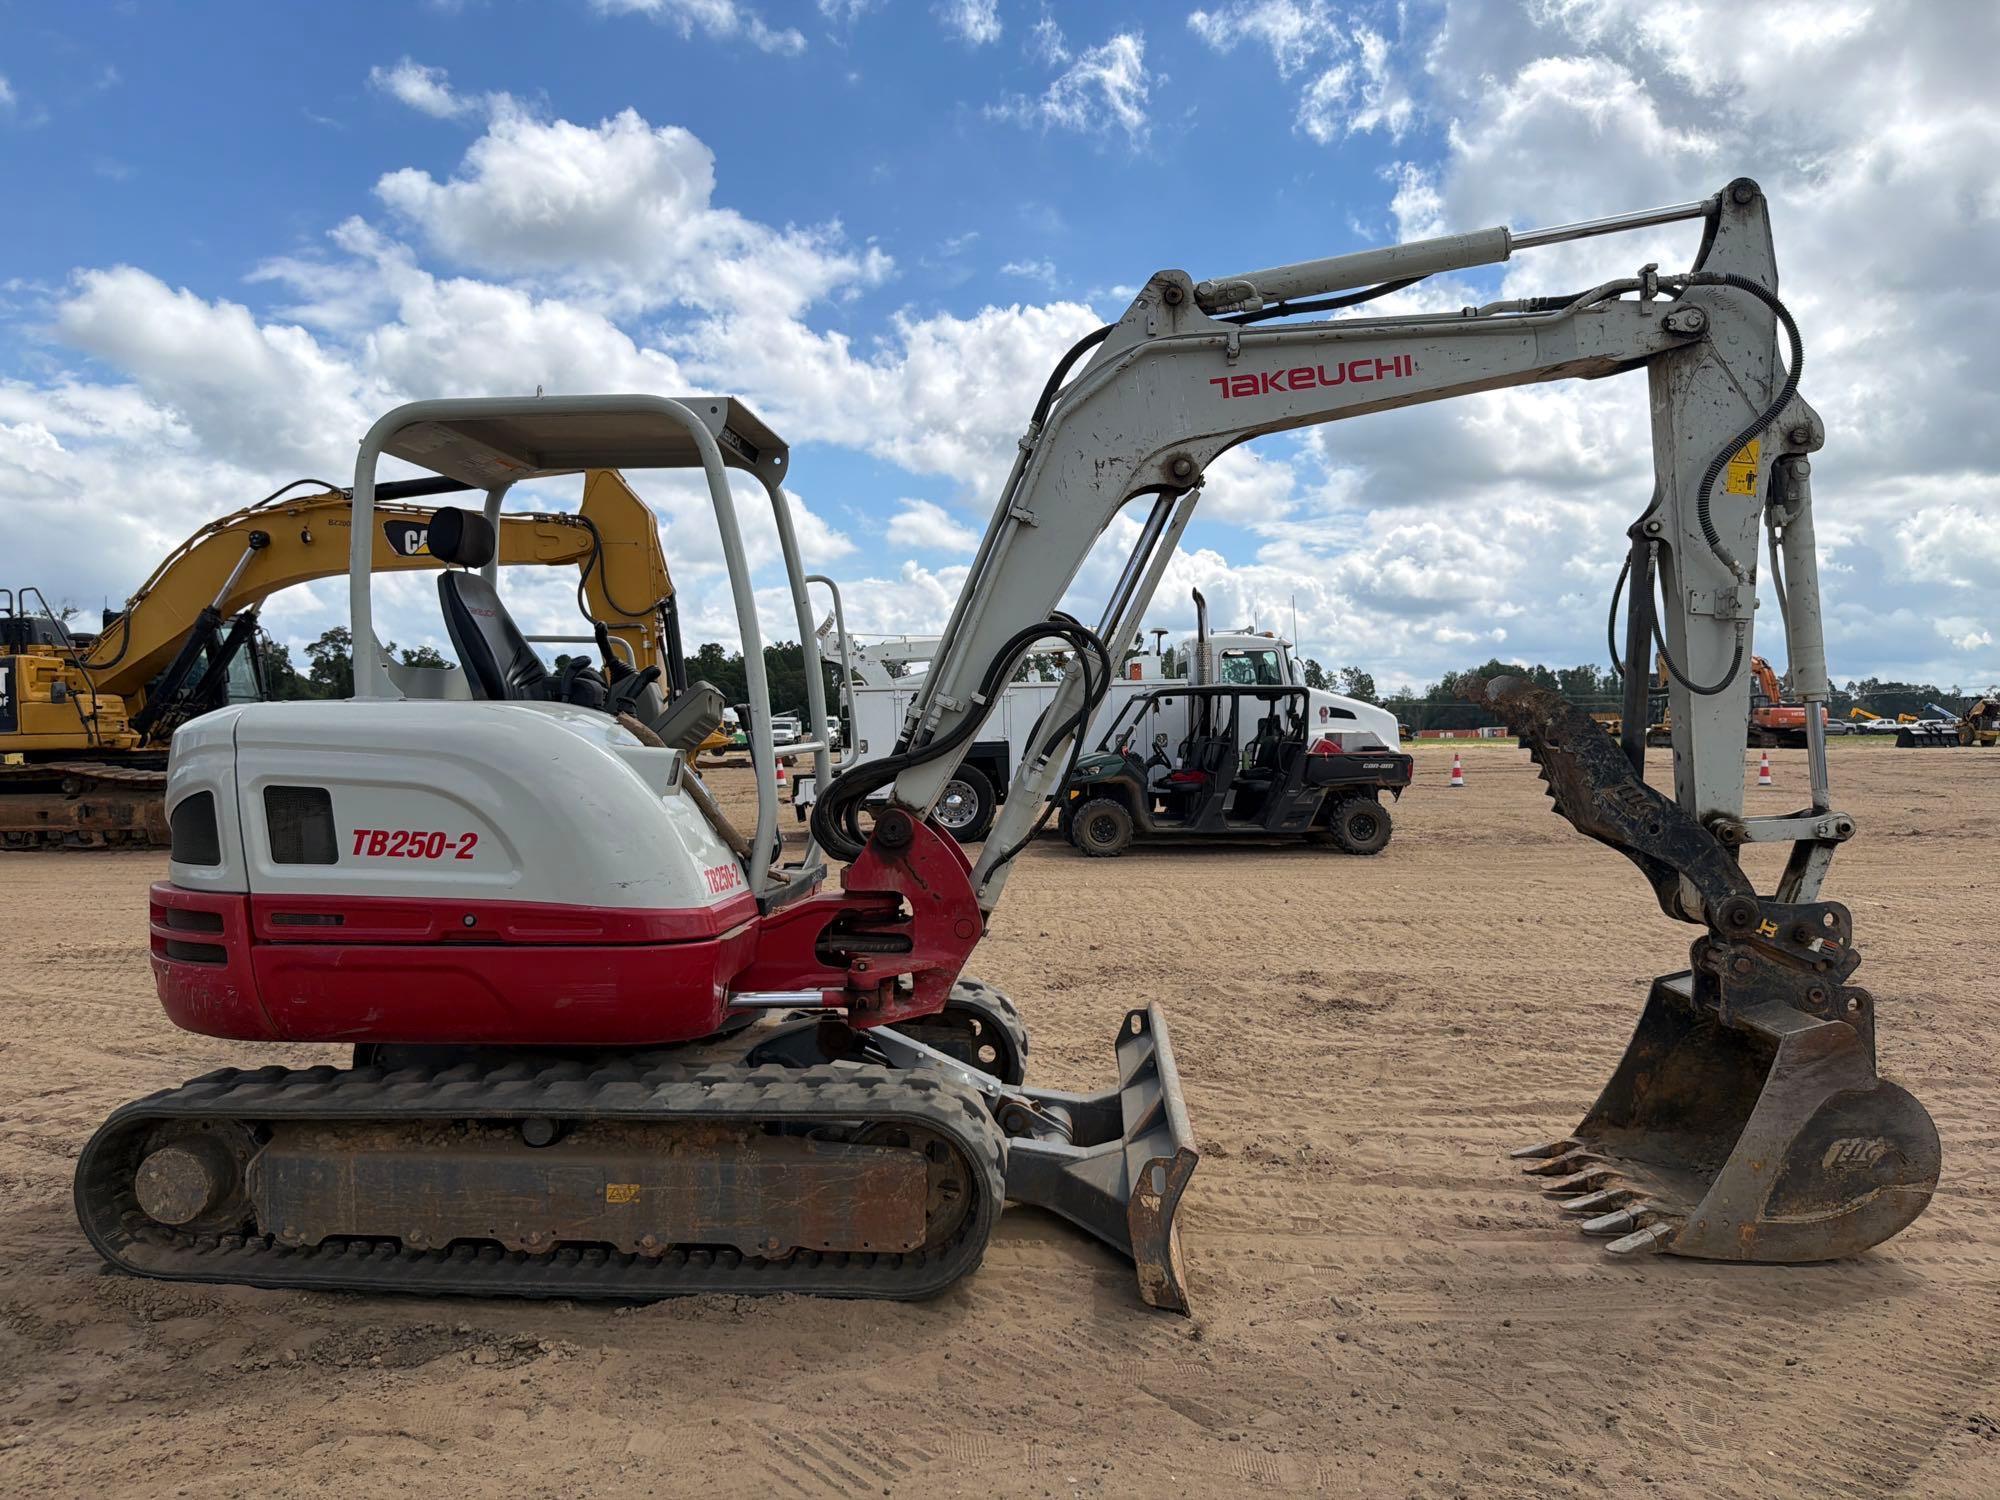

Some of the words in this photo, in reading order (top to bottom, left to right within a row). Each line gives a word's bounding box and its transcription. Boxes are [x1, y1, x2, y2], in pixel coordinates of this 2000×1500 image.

[1209, 354, 1412, 399] TAKEUCHI
[404, 530, 428, 555] CA
[352, 829, 478, 859] TB250-2
[704, 863, 741, 894] TB250-2
